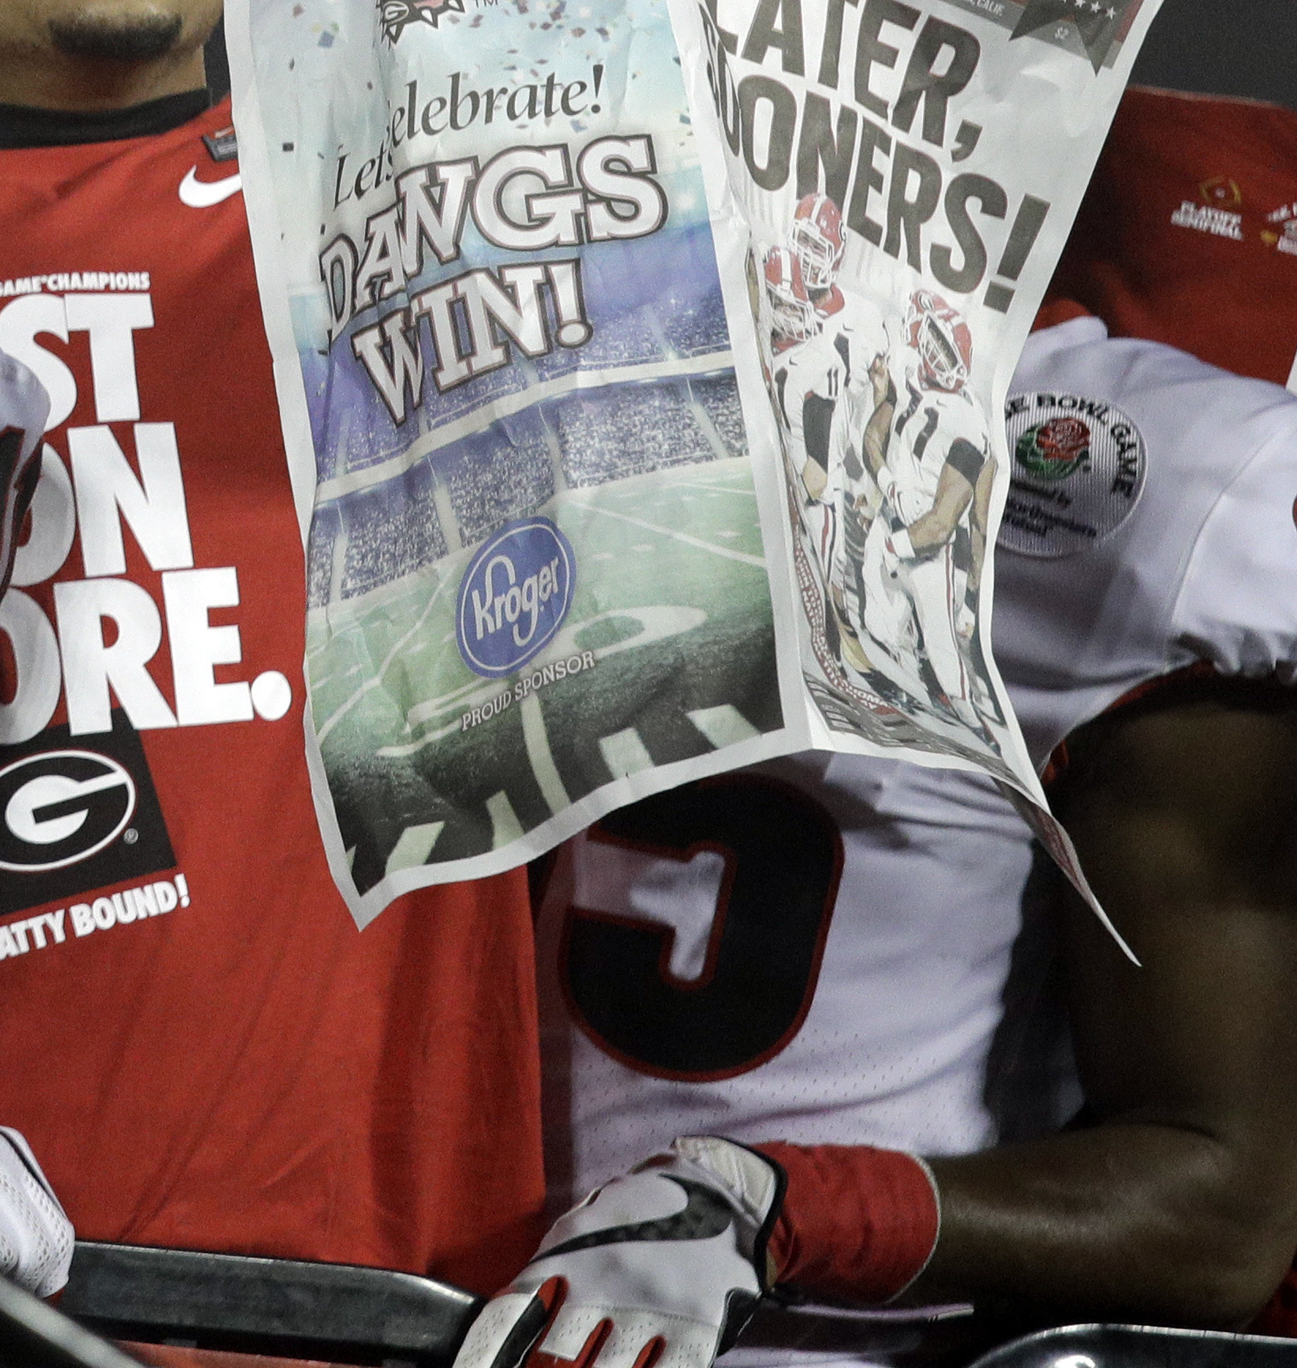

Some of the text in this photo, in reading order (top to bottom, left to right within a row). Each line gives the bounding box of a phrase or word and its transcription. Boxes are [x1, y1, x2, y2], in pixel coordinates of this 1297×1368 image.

[388, 64, 604, 148] elebrate!
[48, 271, 151, 291] CHAMPIONS
[319, 132, 670, 339] DAWGS
[352, 259, 594, 428] WIN!
[1037, 394, 1109, 425] BOWL
[1110, 423, 1138, 498] GAME
[10, 421, 195, 588] ON
[472, 553, 560, 649] Kroger
[461, 650, 595, 731] PROUD SPONSOR
[69, 873, 191, 940] BOUND!
